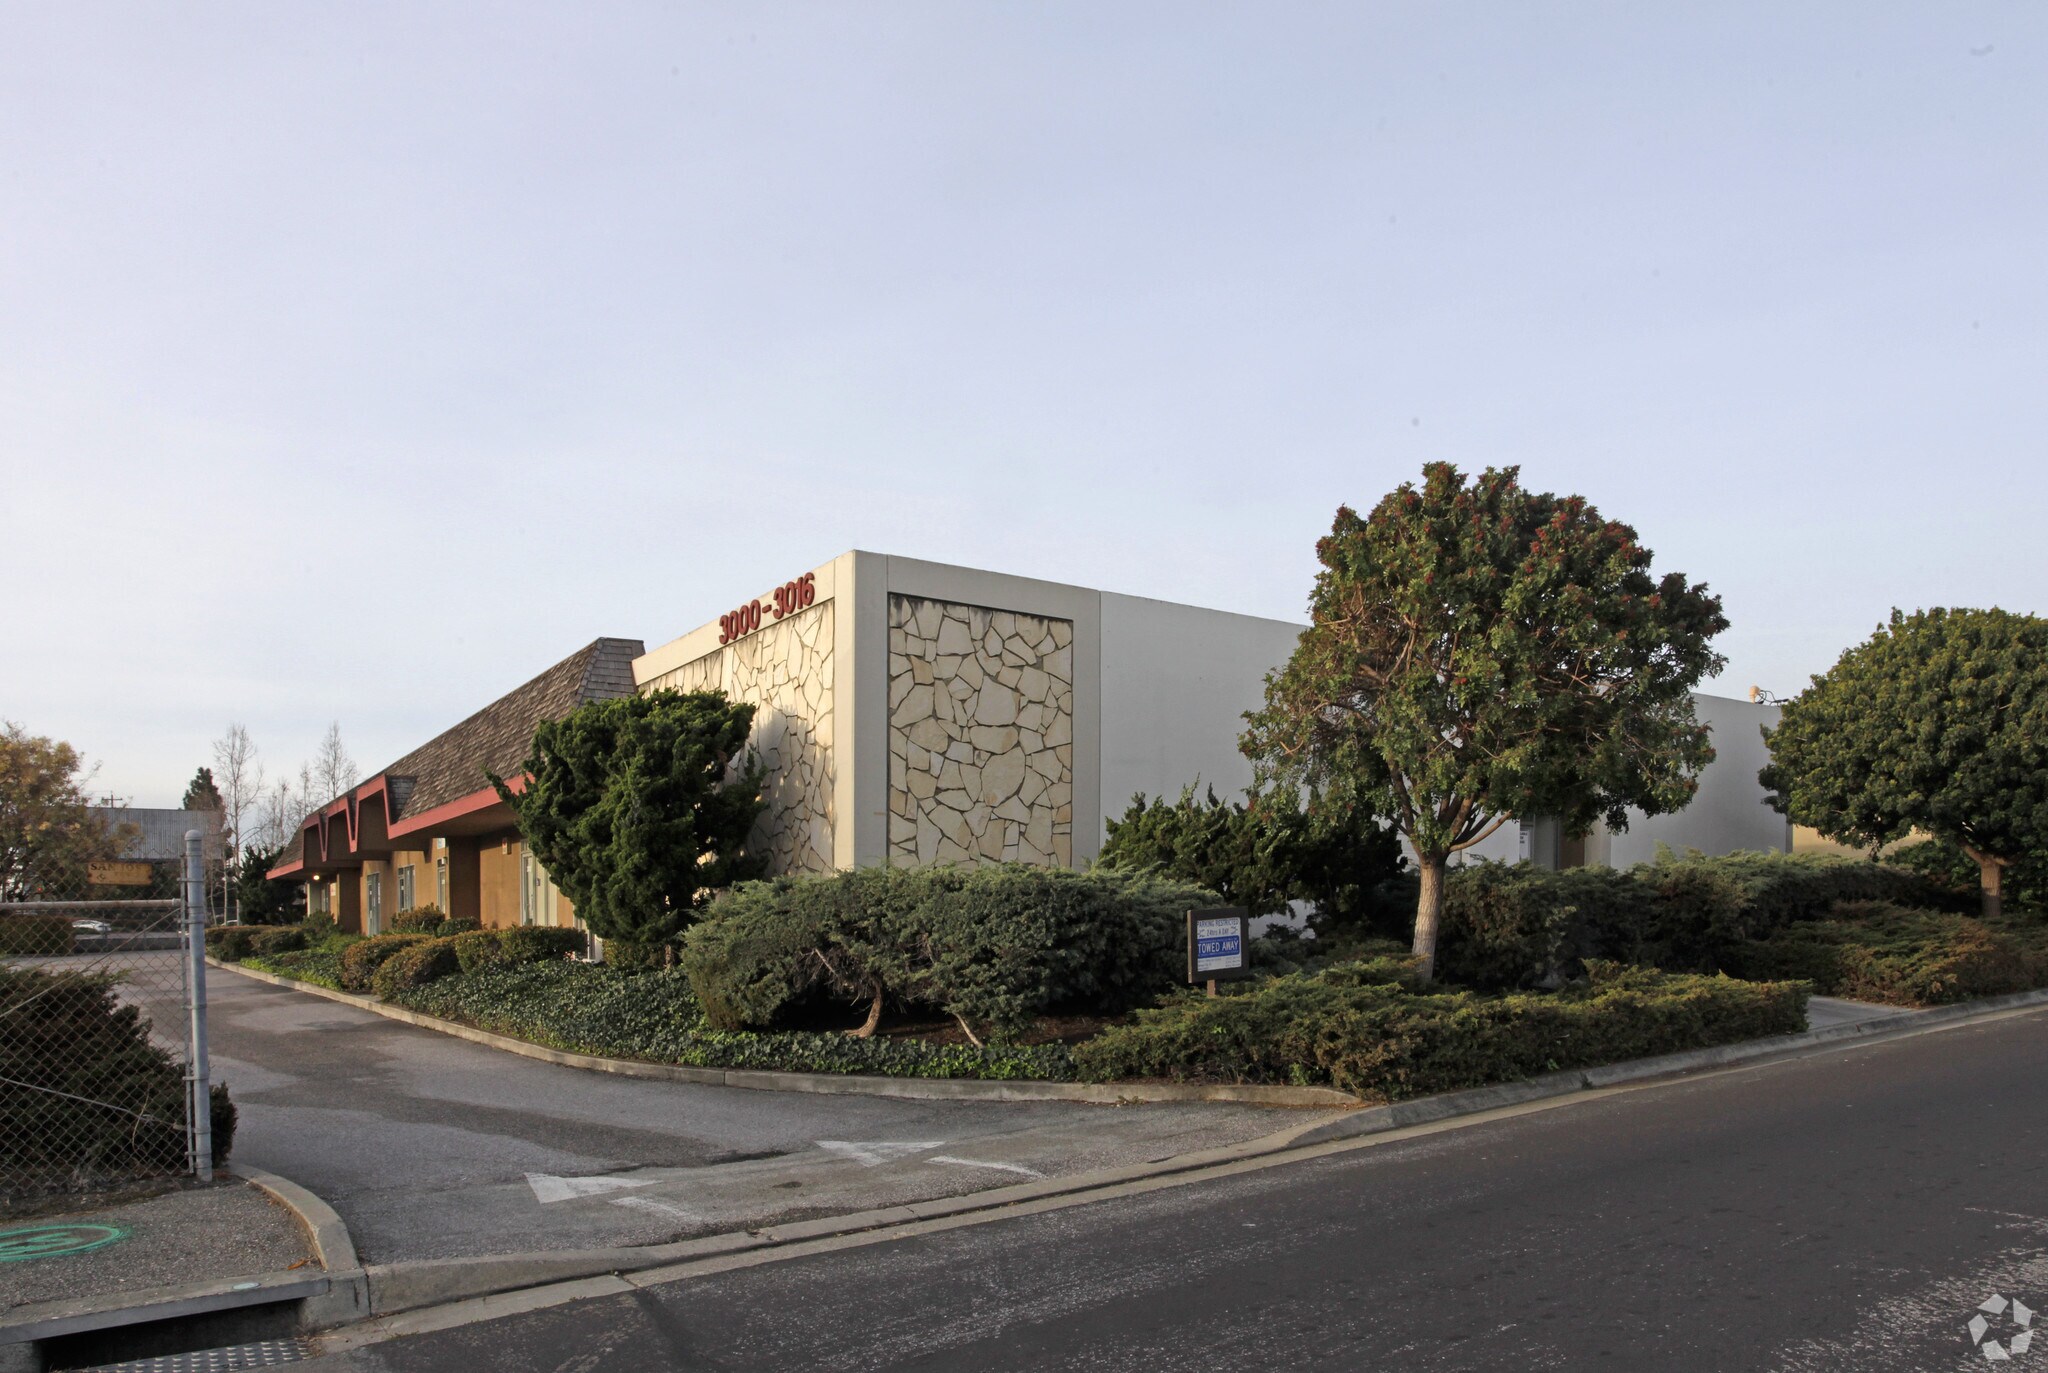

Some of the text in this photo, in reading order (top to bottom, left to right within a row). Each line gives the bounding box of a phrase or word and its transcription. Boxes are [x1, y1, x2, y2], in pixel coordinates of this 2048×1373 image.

[719, 572, 815, 645] 3000-3016
[1198, 942, 1220, 954] TOWED
[1222, 939, 1239, 951] AWAY
